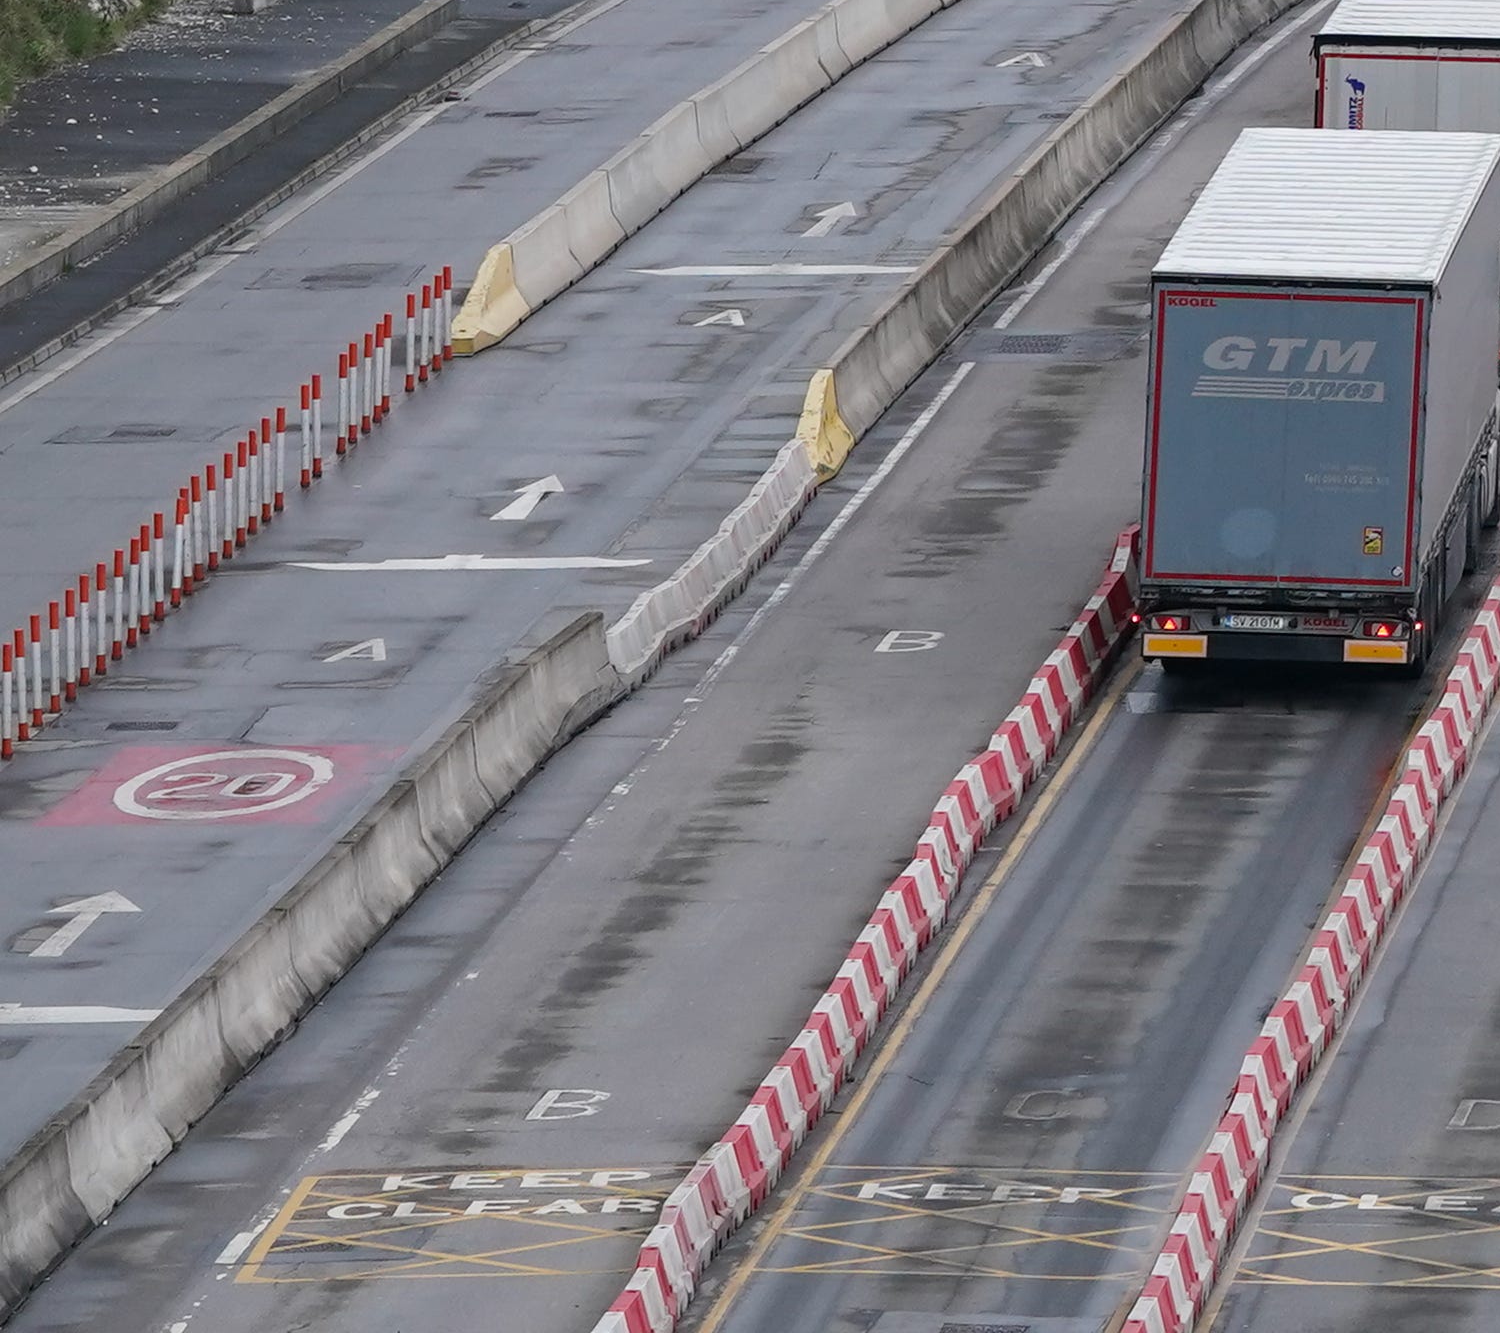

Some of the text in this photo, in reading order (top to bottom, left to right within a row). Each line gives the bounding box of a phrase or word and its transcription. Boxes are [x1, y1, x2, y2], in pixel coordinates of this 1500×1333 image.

[1202, 335, 1378, 374] GTM
[1286, 378, 1379, 401] expres
[1232, 615, 1246, 629] SV
[145, 771, 296, 801] 20
[524, 1088, 611, 1121] B
[381, 1169, 653, 1193] KEEP
[857, 1180, 1117, 1204] KEEP
[325, 1196, 662, 1220] CLEAR
